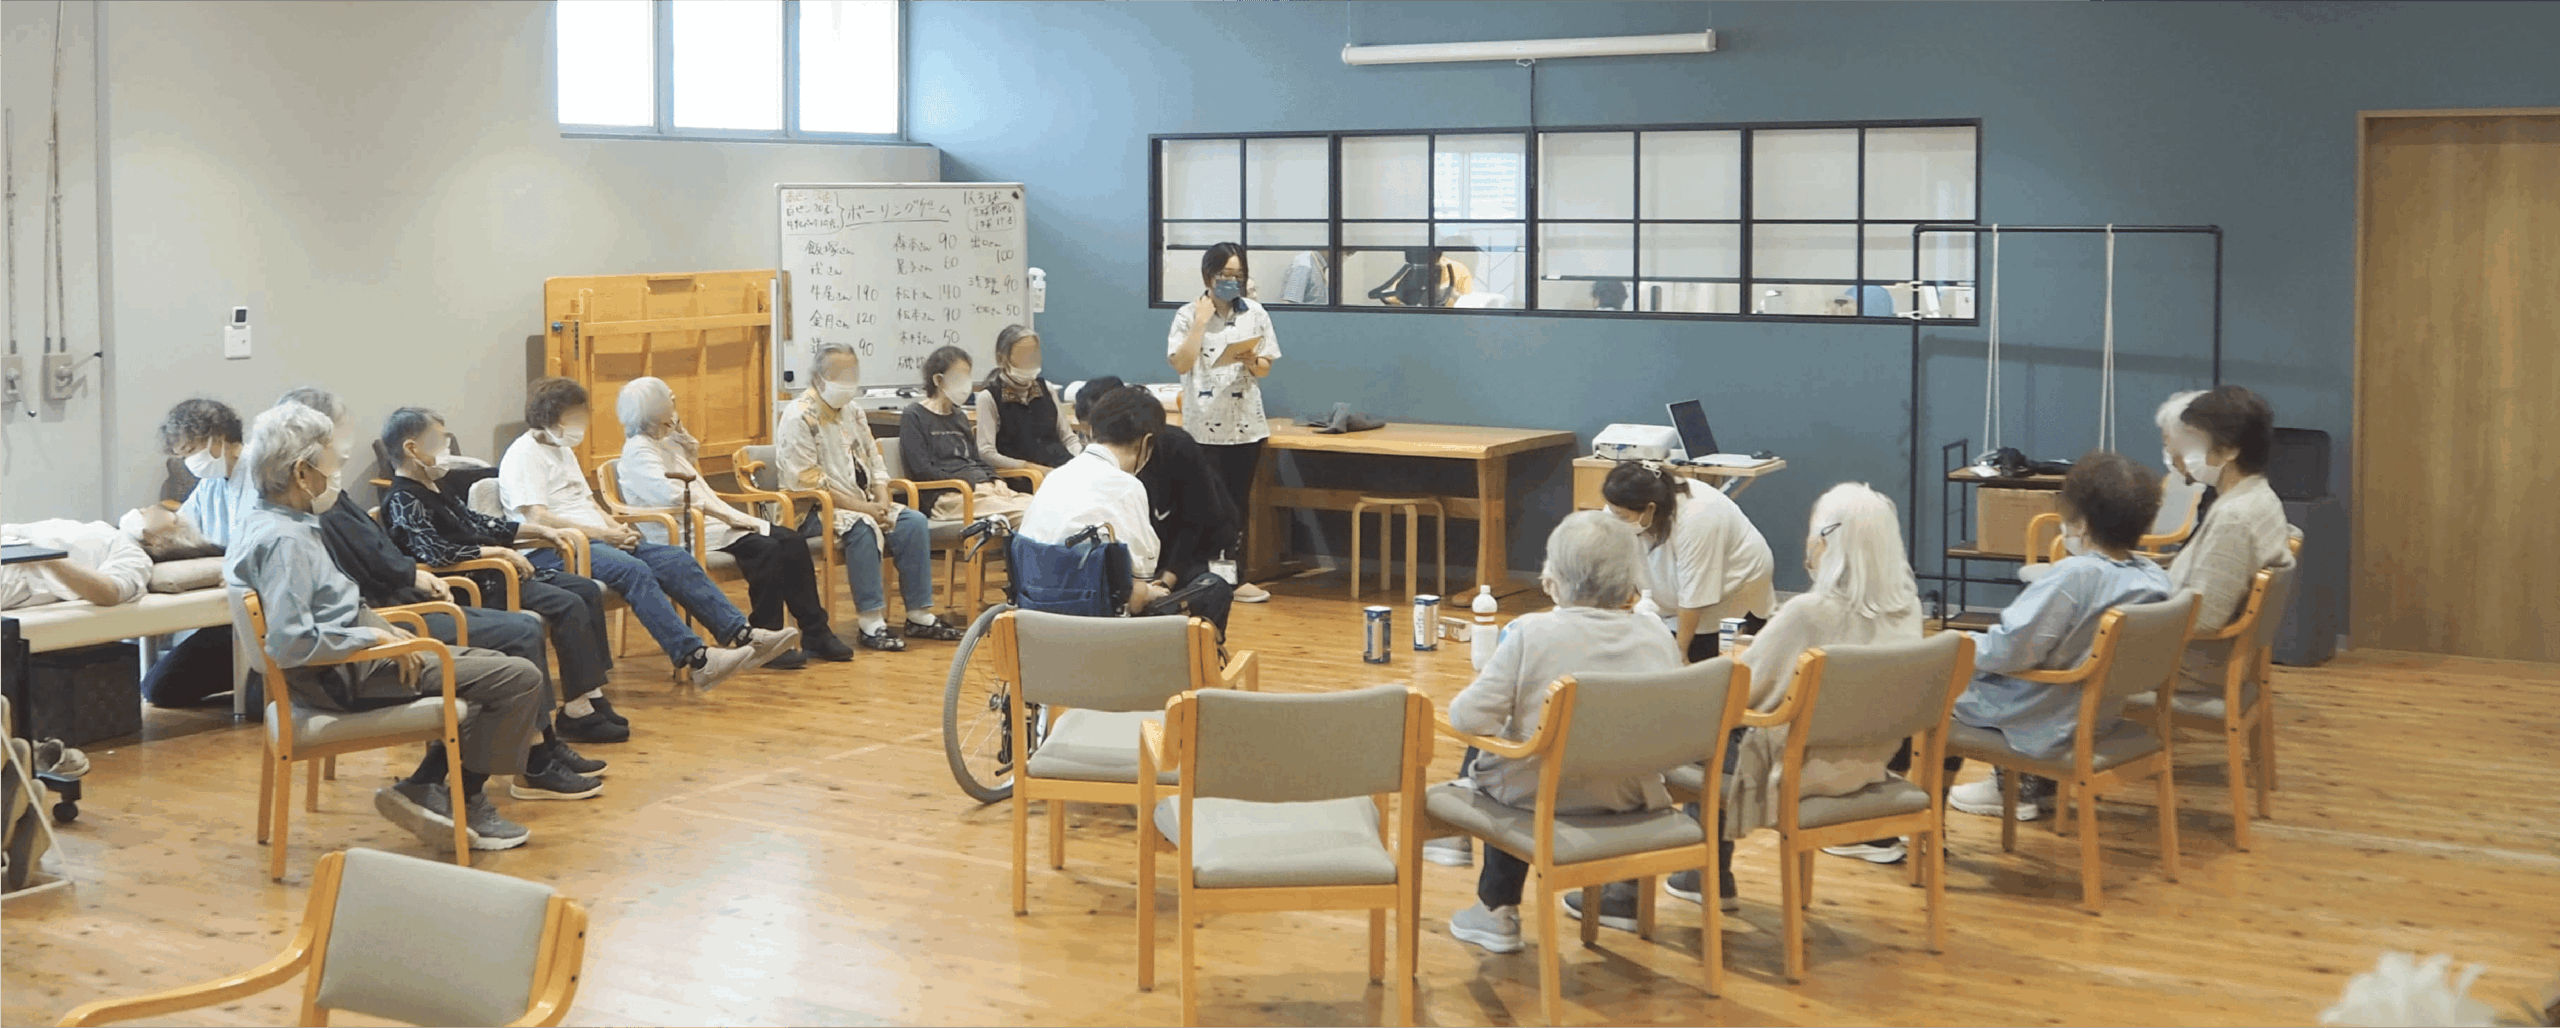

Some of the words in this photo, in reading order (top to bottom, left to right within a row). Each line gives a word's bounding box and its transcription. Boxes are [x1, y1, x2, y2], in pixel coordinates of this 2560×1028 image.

[846, 197, 952, 220] ボーリングゲーム
[938, 232, 958, 250] 90
[997, 249, 1015, 264] 100
[938, 284, 961, 301] 140
[1004, 274, 1019, 294] 90
[856, 284, 879, 302] 190
[942, 306, 962, 322] 90
[1005, 303, 1021, 317] 50
[856, 312, 877, 326] 120
[943, 329, 960, 346] 50
[859, 337, 875, 356] 90
